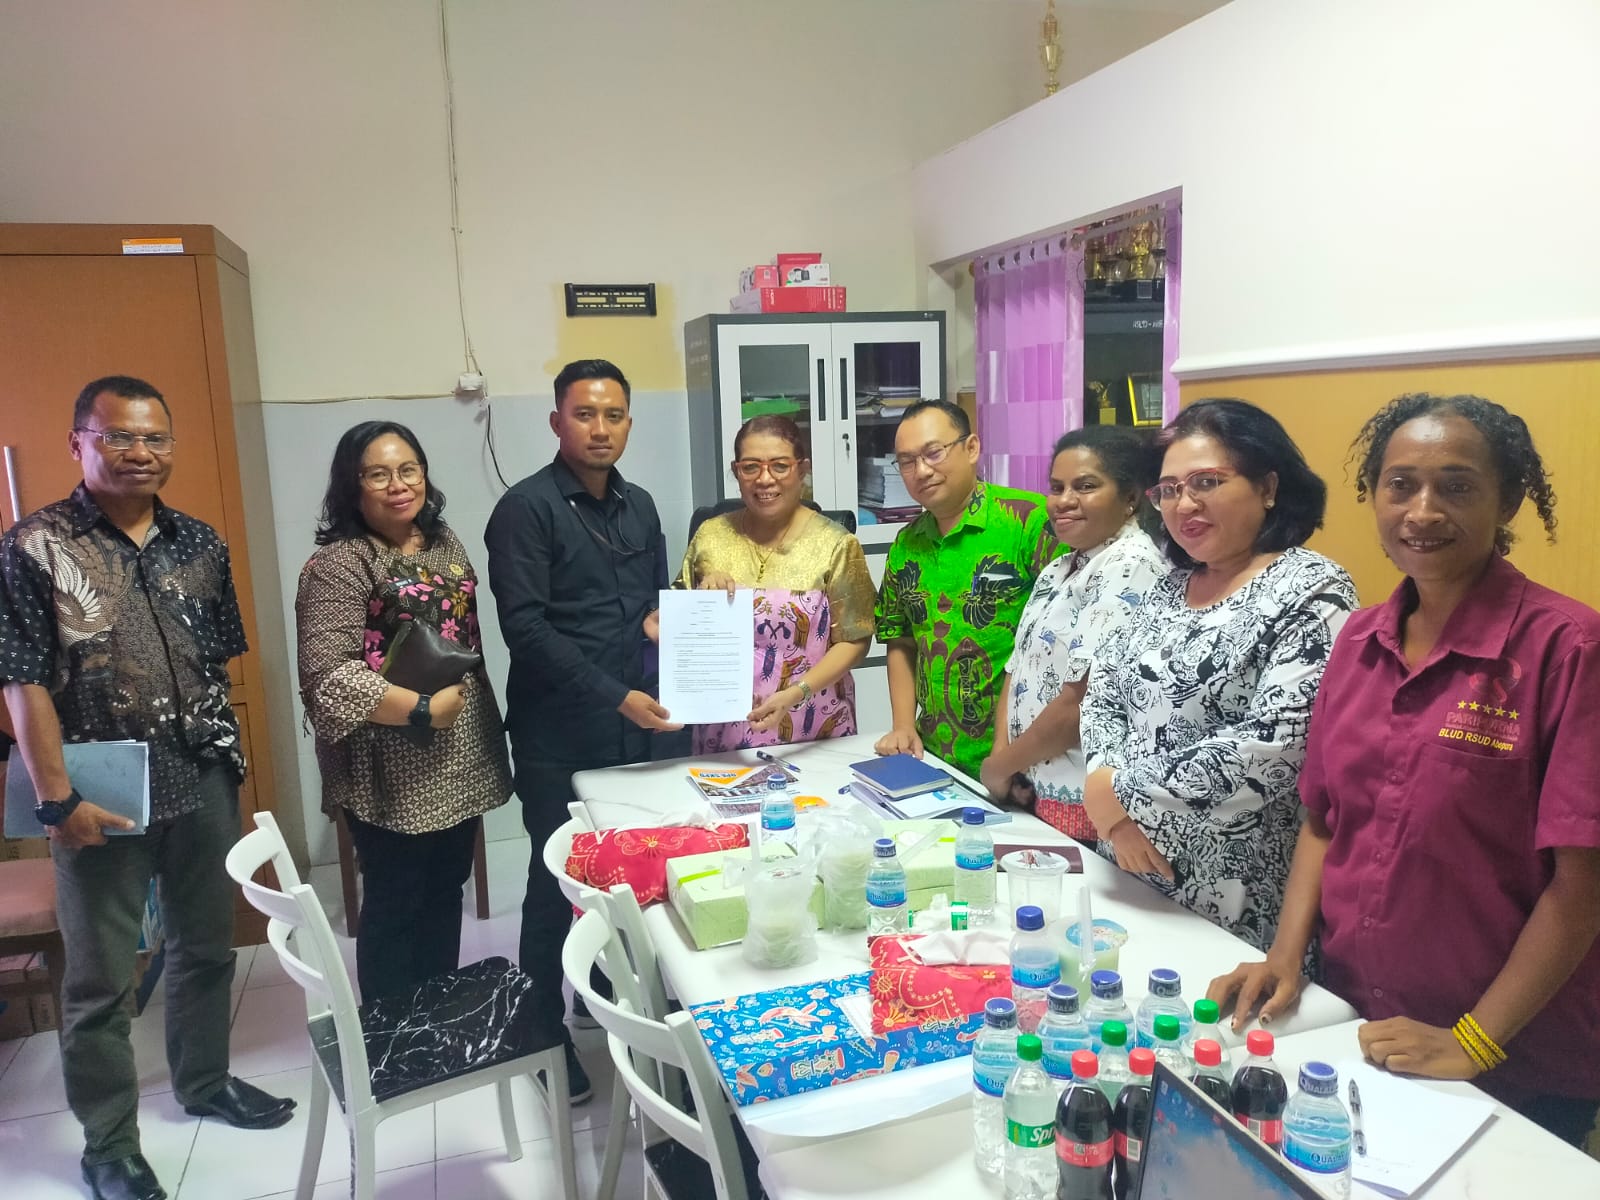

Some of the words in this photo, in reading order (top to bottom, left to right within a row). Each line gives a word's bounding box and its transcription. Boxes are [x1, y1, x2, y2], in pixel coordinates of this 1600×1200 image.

[1438, 727, 1464, 740] BLUD
[1464, 732, 1491, 746] RSUD
[985, 1077, 1006, 1090] QUA
